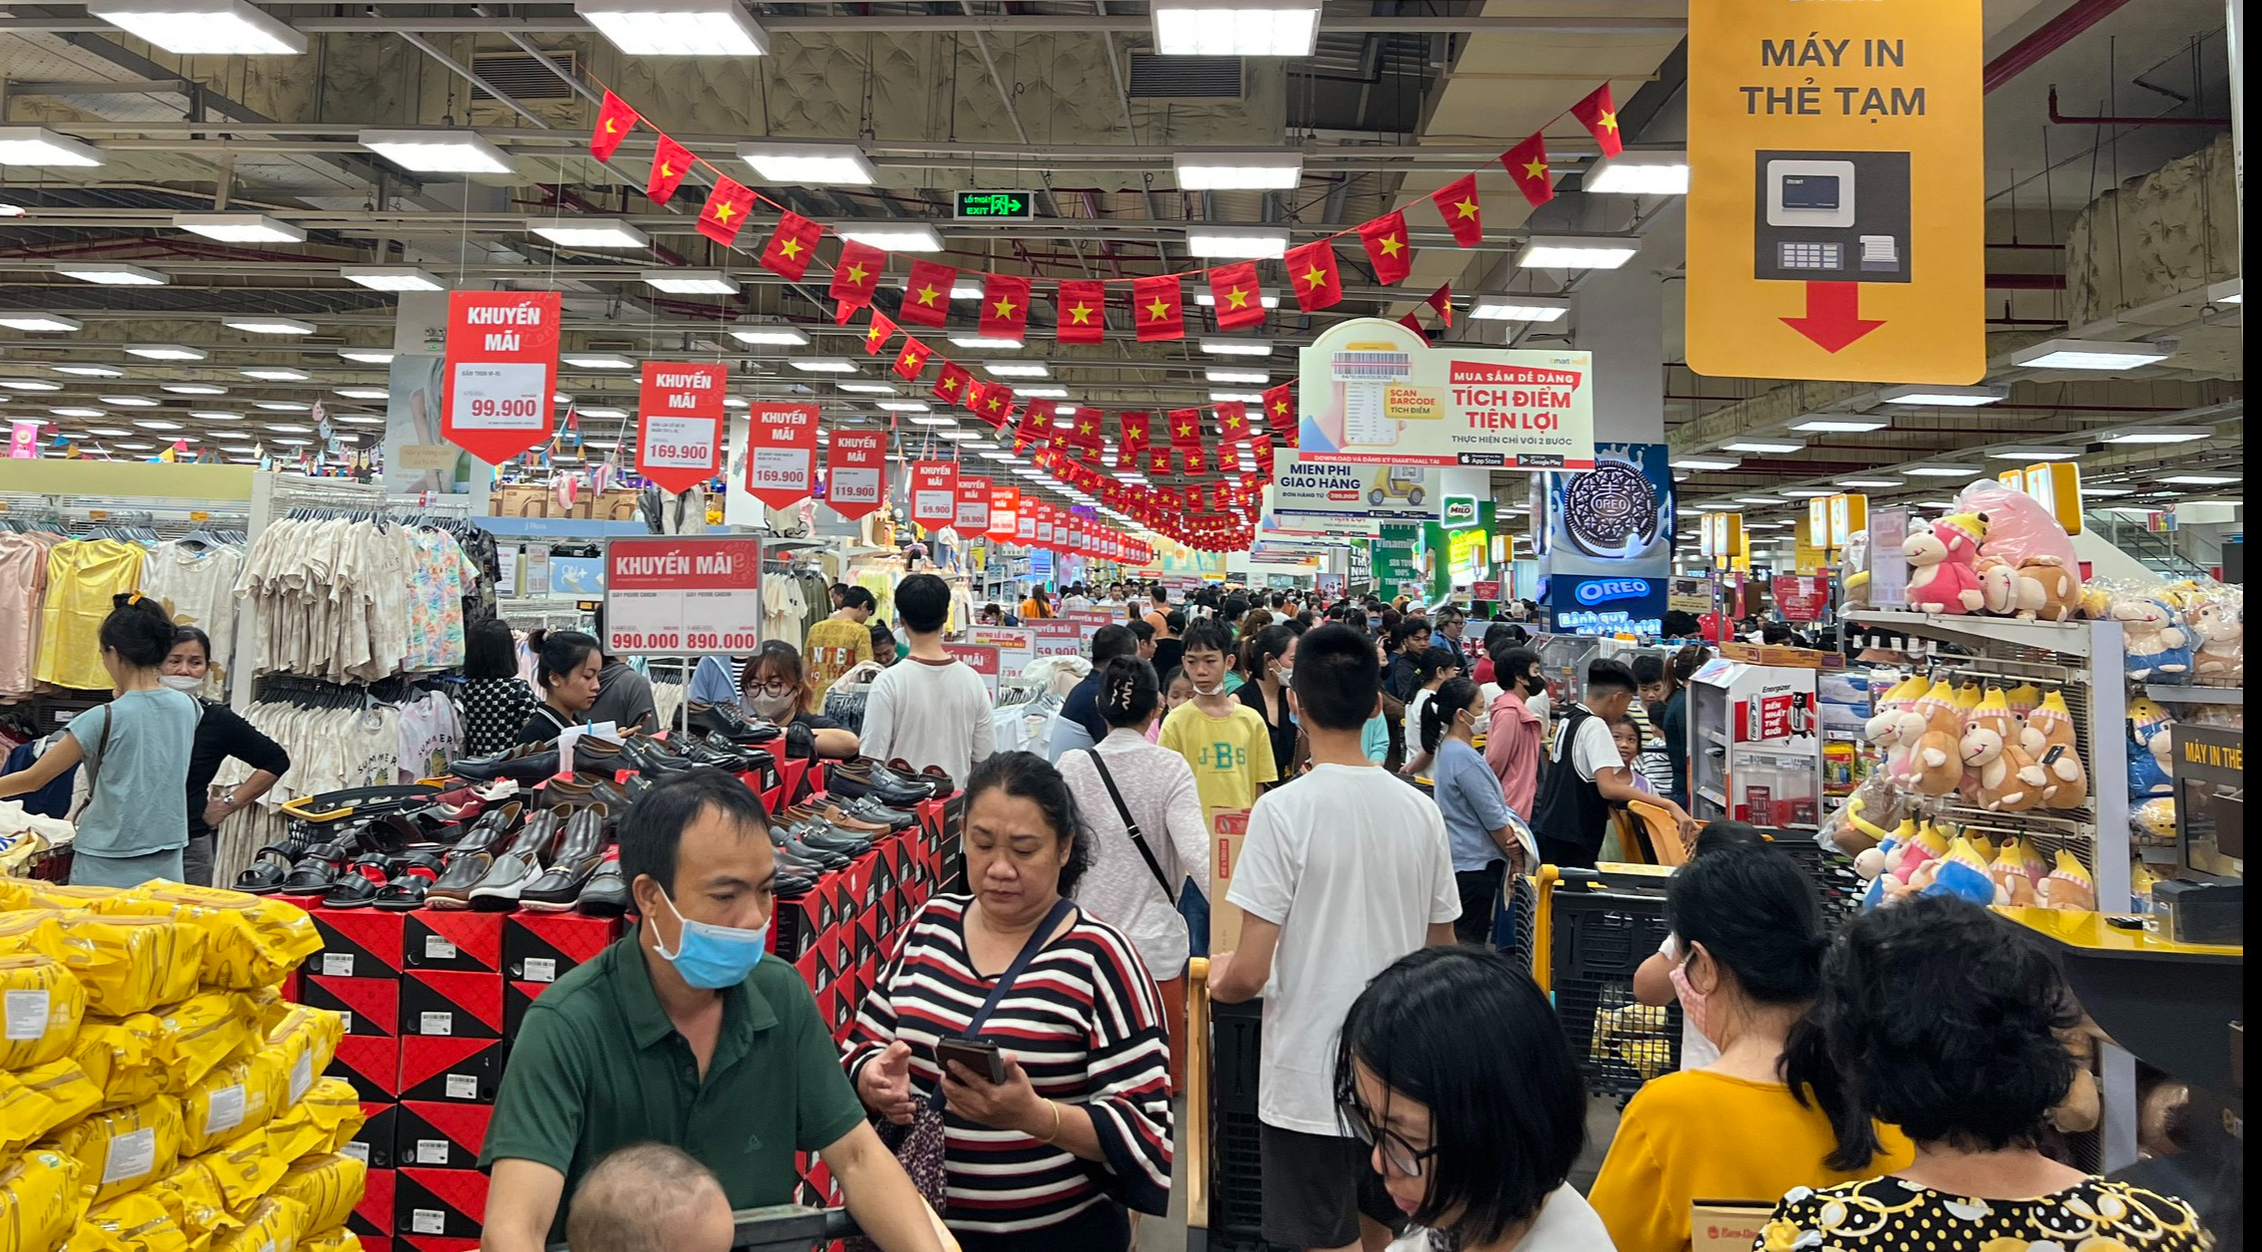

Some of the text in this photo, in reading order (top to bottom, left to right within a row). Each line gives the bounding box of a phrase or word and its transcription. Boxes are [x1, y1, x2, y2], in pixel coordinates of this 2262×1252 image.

[1761, 31, 1904, 67] MÁY IN
[1739, 77, 1925, 124] THẺ TẠM
[966, 207, 989, 215] EXIT
[467, 301, 541, 325] KHUYẾN
[485, 330, 520, 352] MÃI
[656, 371, 712, 390] KHUYẾN
[1454, 372, 1483, 382] MUA
[1486, 369, 1515, 382] SẮM
[1537, 373, 1574, 383] DÀNG
[1390, 389, 1417, 397] SCAN
[1452, 386, 1571, 408] TÍCH ĐIỂM
[471, 399, 537, 417] 99.900
[669, 394, 696, 409] MÃI
[1390, 397, 1436, 405] BARCODE
[1410, 405, 1430, 414] ĐIỂM
[761, 409, 807, 425] KHUYẾN
[1465, 408, 1558, 434] TIỆN LỢI
[772, 426, 794, 441] MÃI
[1452, 434, 1572, 445] THỰC HIỆN CHỈ VỚI 2 BƯỚC
[838, 435, 877, 449] KHUYẾN
[650, 444, 707, 459] 169.900
[847, 449, 866, 462] MÃI
[757, 470, 804, 482] 169.900
[920, 464, 951, 475] KHUYẾN
[927, 476, 942, 486] MÃI
[1281, 476, 1360, 489] GIAO HÀNG
[835, 486, 875, 497] 119.900
[965, 489, 979, 499] MÃI
[922, 505, 950, 514] 69.900
[1450, 506, 1471, 514] MILO
[1595, 498, 1627, 510] OREO
[615, 549, 732, 575] KHUYẾN MÃI
[1580, 581, 1647, 600] OREO
[1561, 611, 1627, 625] Bánh quy
[612, 633, 679, 649] 990.000
[687, 633, 754, 649] 890.000
[1762, 684, 1791, 694] Energizer
[2185, 738, 2243, 771] MÁY IN THẺ
[357, 752, 398, 775] SUMMER
